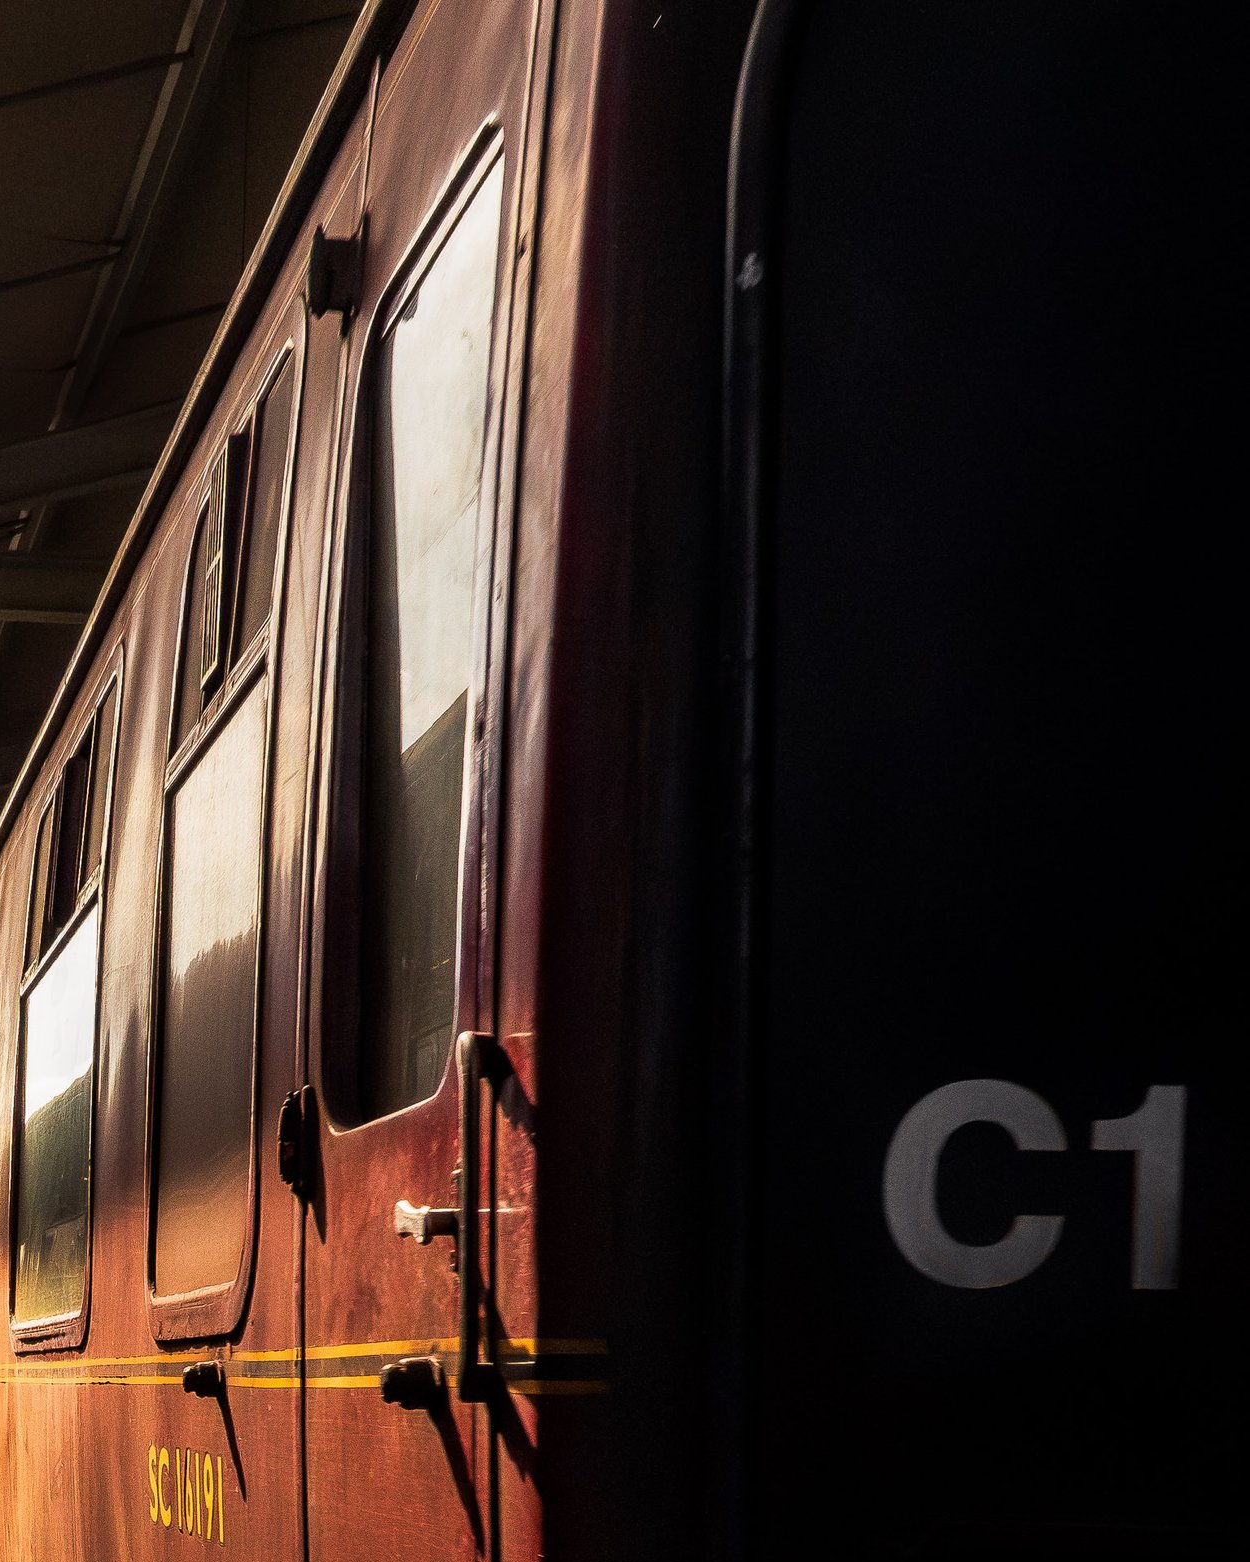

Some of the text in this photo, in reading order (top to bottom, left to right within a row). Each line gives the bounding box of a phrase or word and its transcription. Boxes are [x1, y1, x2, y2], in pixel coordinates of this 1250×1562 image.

[881, 1078, 1189, 1291] C1
[149, 1444, 225, 1546] SC 16191
